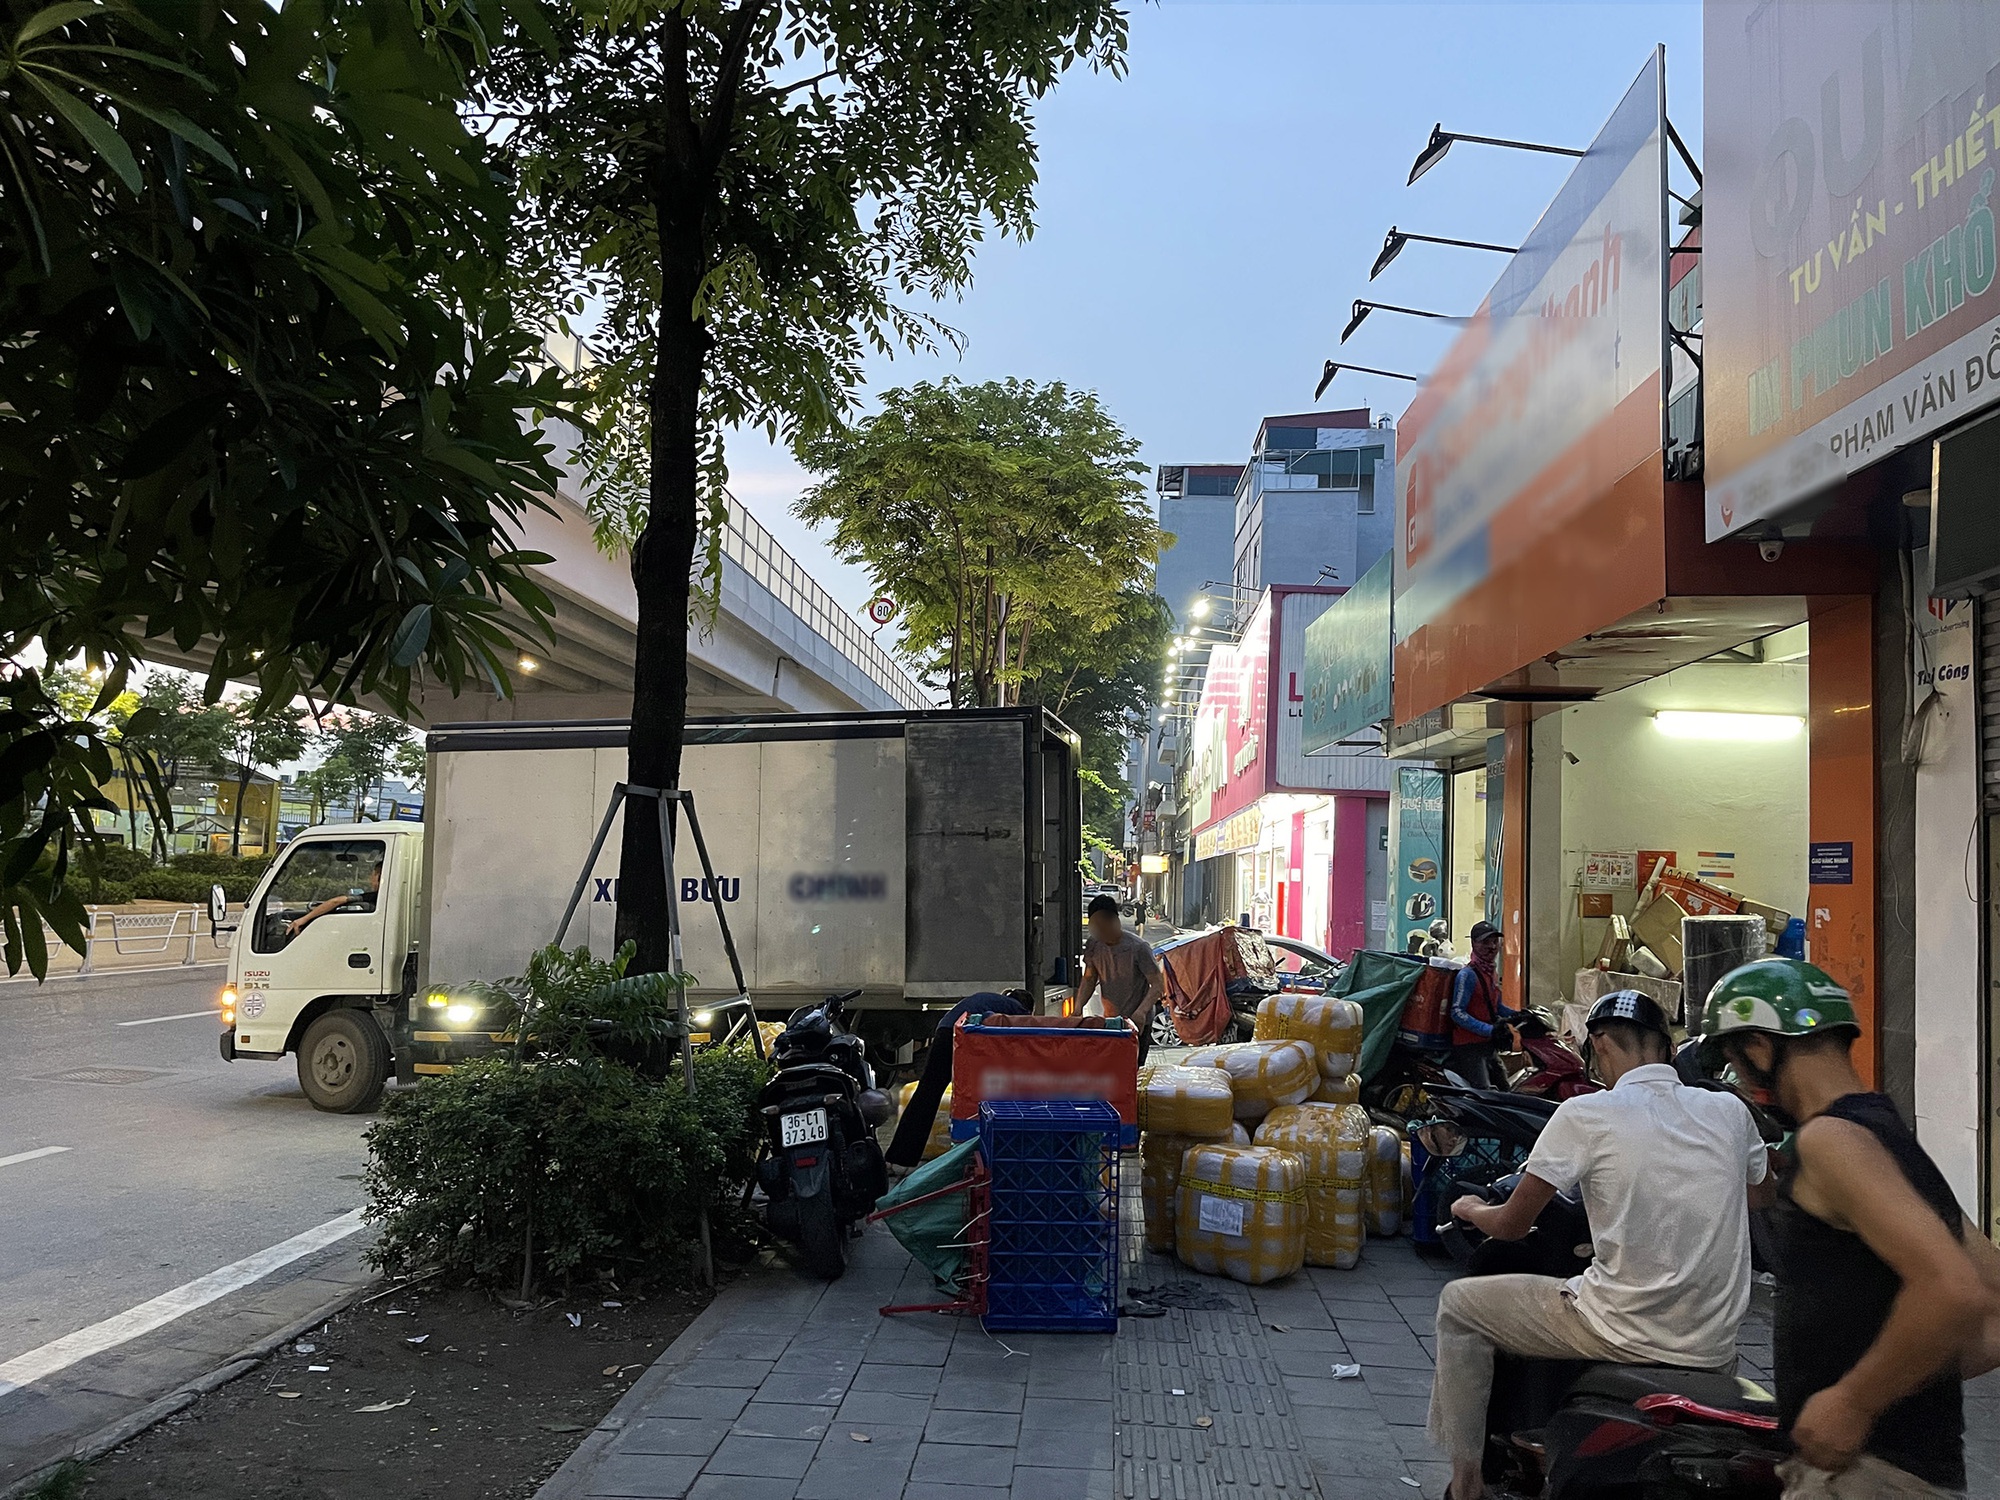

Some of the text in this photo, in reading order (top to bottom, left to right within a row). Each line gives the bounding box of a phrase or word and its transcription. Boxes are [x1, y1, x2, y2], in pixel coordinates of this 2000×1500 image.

[1827, 196, 1886, 273] VẤN
[1748, 355, 1783, 437] IN
[1791, 276, 1893, 412] PHUN
[1903, 167, 1997, 340] KHỔ
[1830, 403, 1895, 459] PHẠM
[1903, 371, 1956, 425] VĂN
[877, 605, 889, 617] 80
[1938, 663, 1970, 682] Công
[681, 875, 740, 903] BƯU
[788, 1112, 819, 1129] 36-C1
[785, 1125, 824, 1144] 373.48
